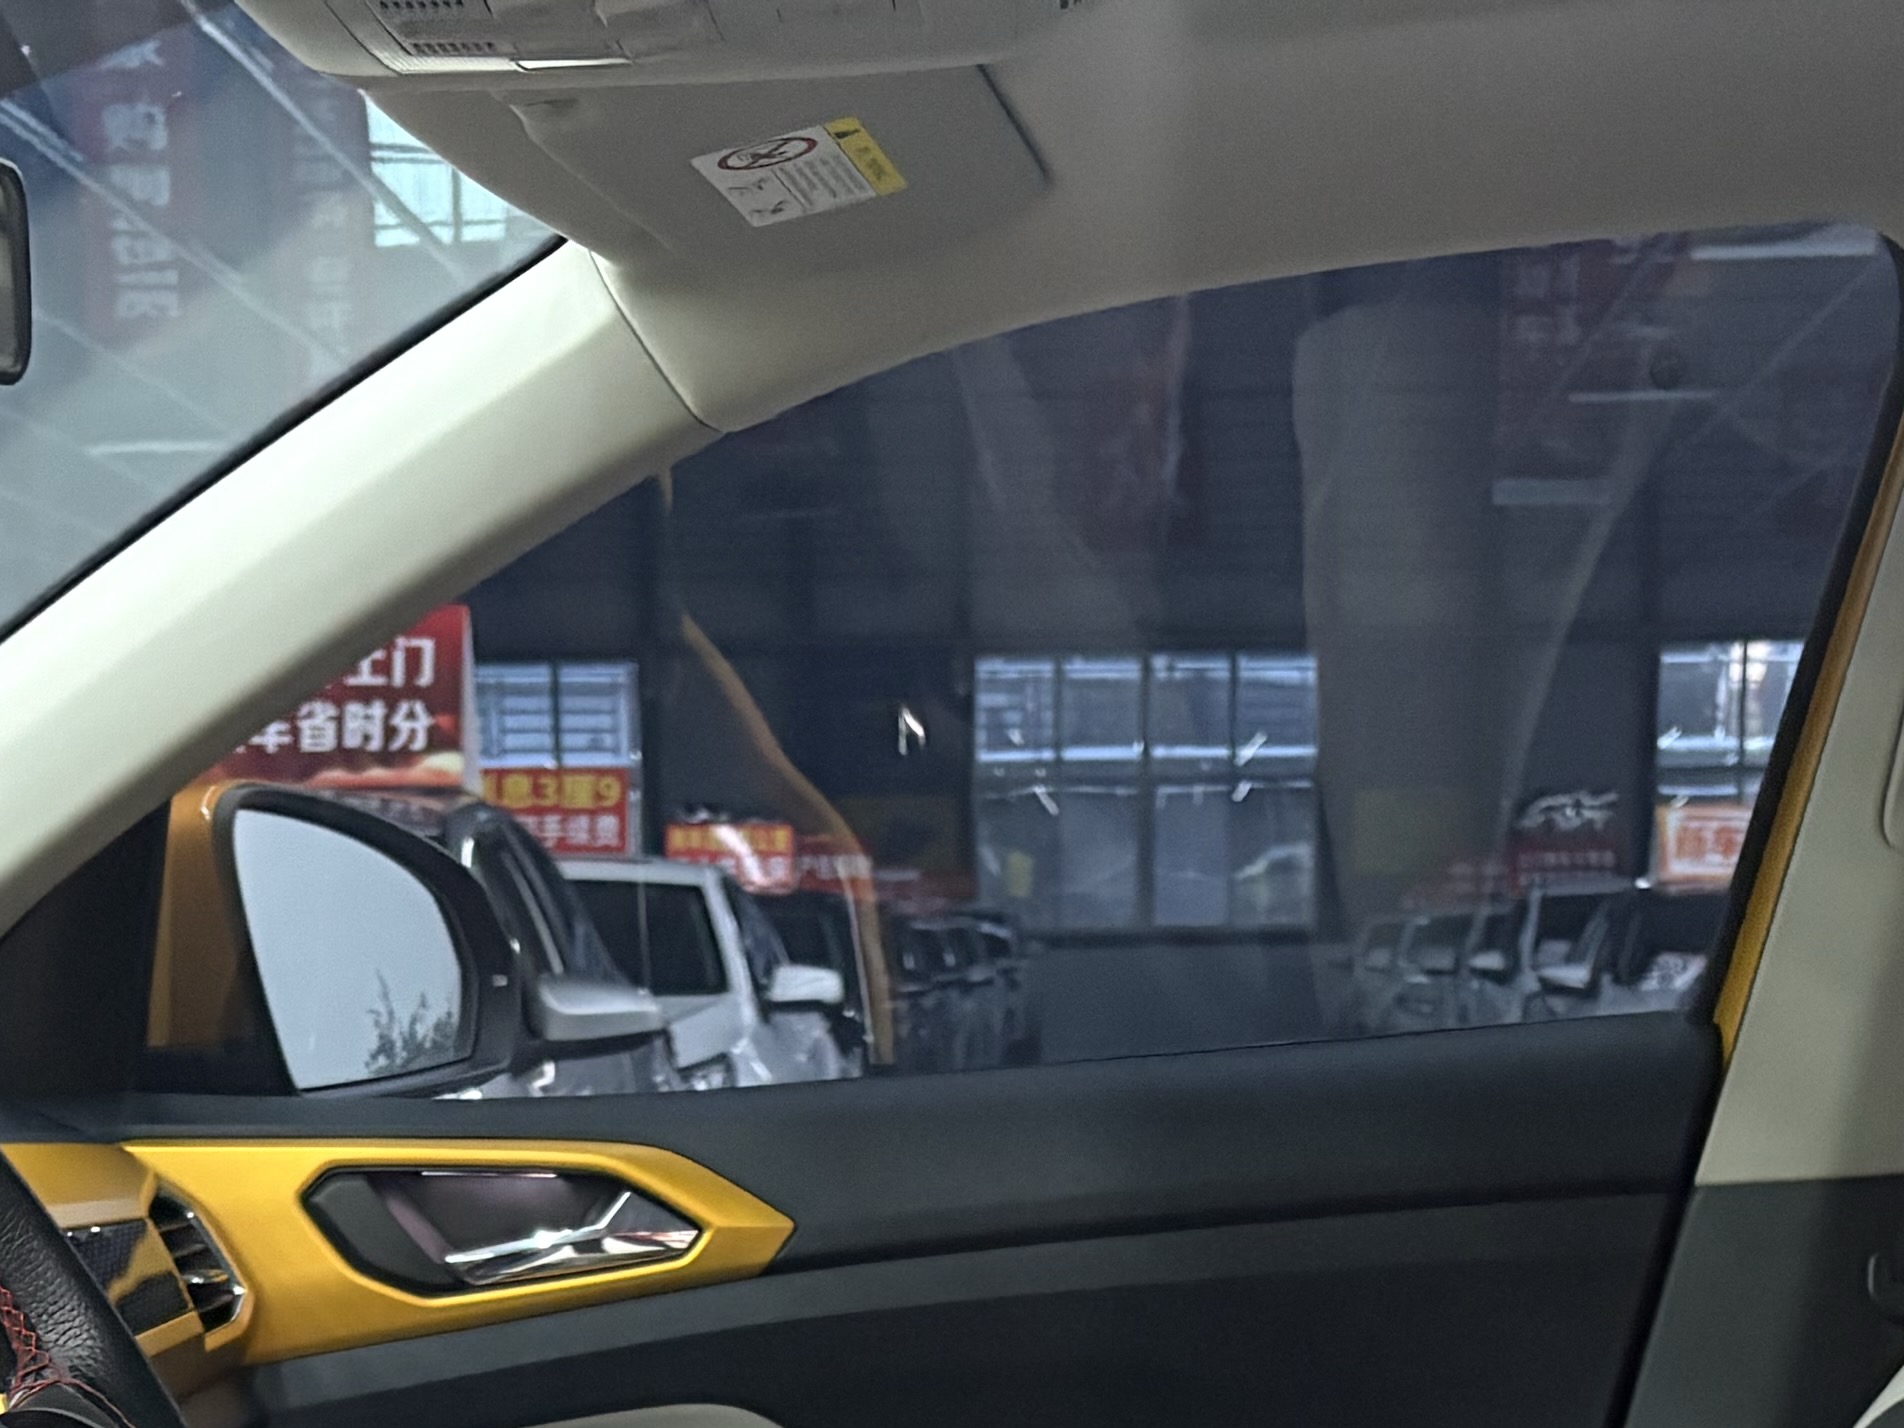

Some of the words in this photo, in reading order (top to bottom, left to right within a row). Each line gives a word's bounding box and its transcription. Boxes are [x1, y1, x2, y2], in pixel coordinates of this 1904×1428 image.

[327, 636, 436, 688] 上门
[235, 699, 436, 753] 车省时分
